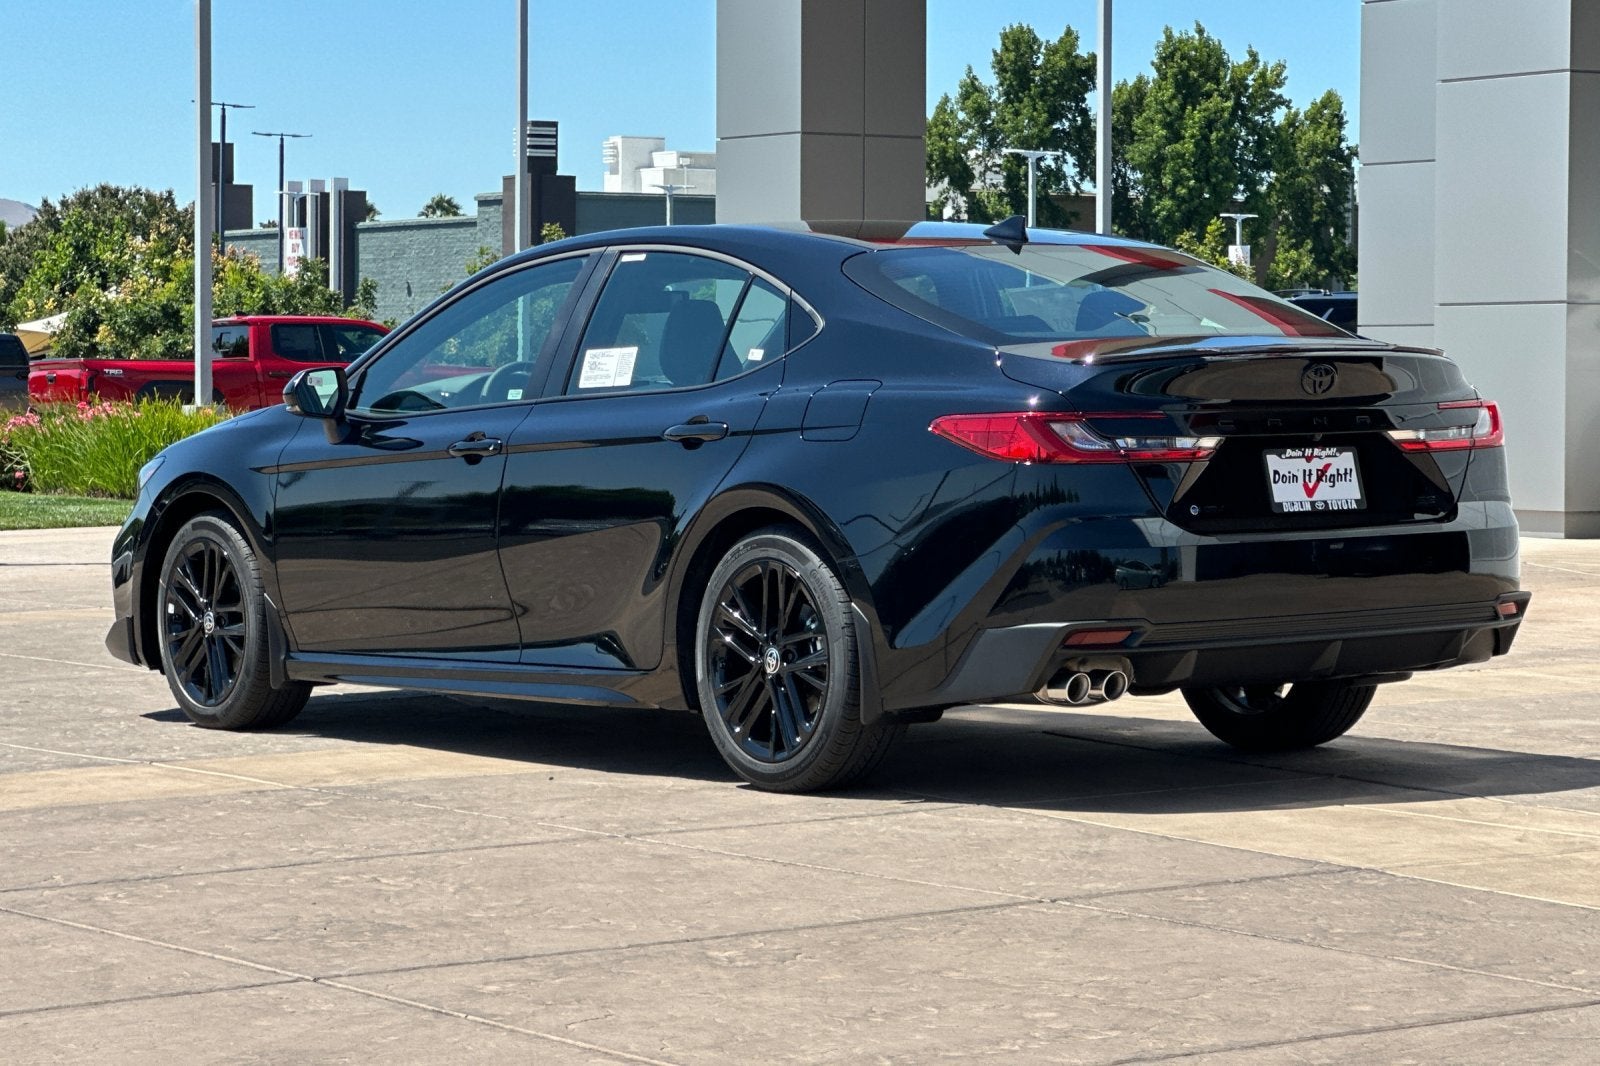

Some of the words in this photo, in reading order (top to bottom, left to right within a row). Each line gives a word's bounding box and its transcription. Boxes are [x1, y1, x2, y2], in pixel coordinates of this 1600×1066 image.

[1285, 448, 1304, 458] Doin'
[1304, 448, 1313, 457] It
[1313, 447, 1337, 459] Right!
[1272, 469, 1300, 485] Doin'
[1302, 468, 1314, 484] It
[1315, 467, 1353, 489] Right!
[1282, 500, 1312, 512] DUBLIN
[1326, 498, 1357, 511] TOYOTA
